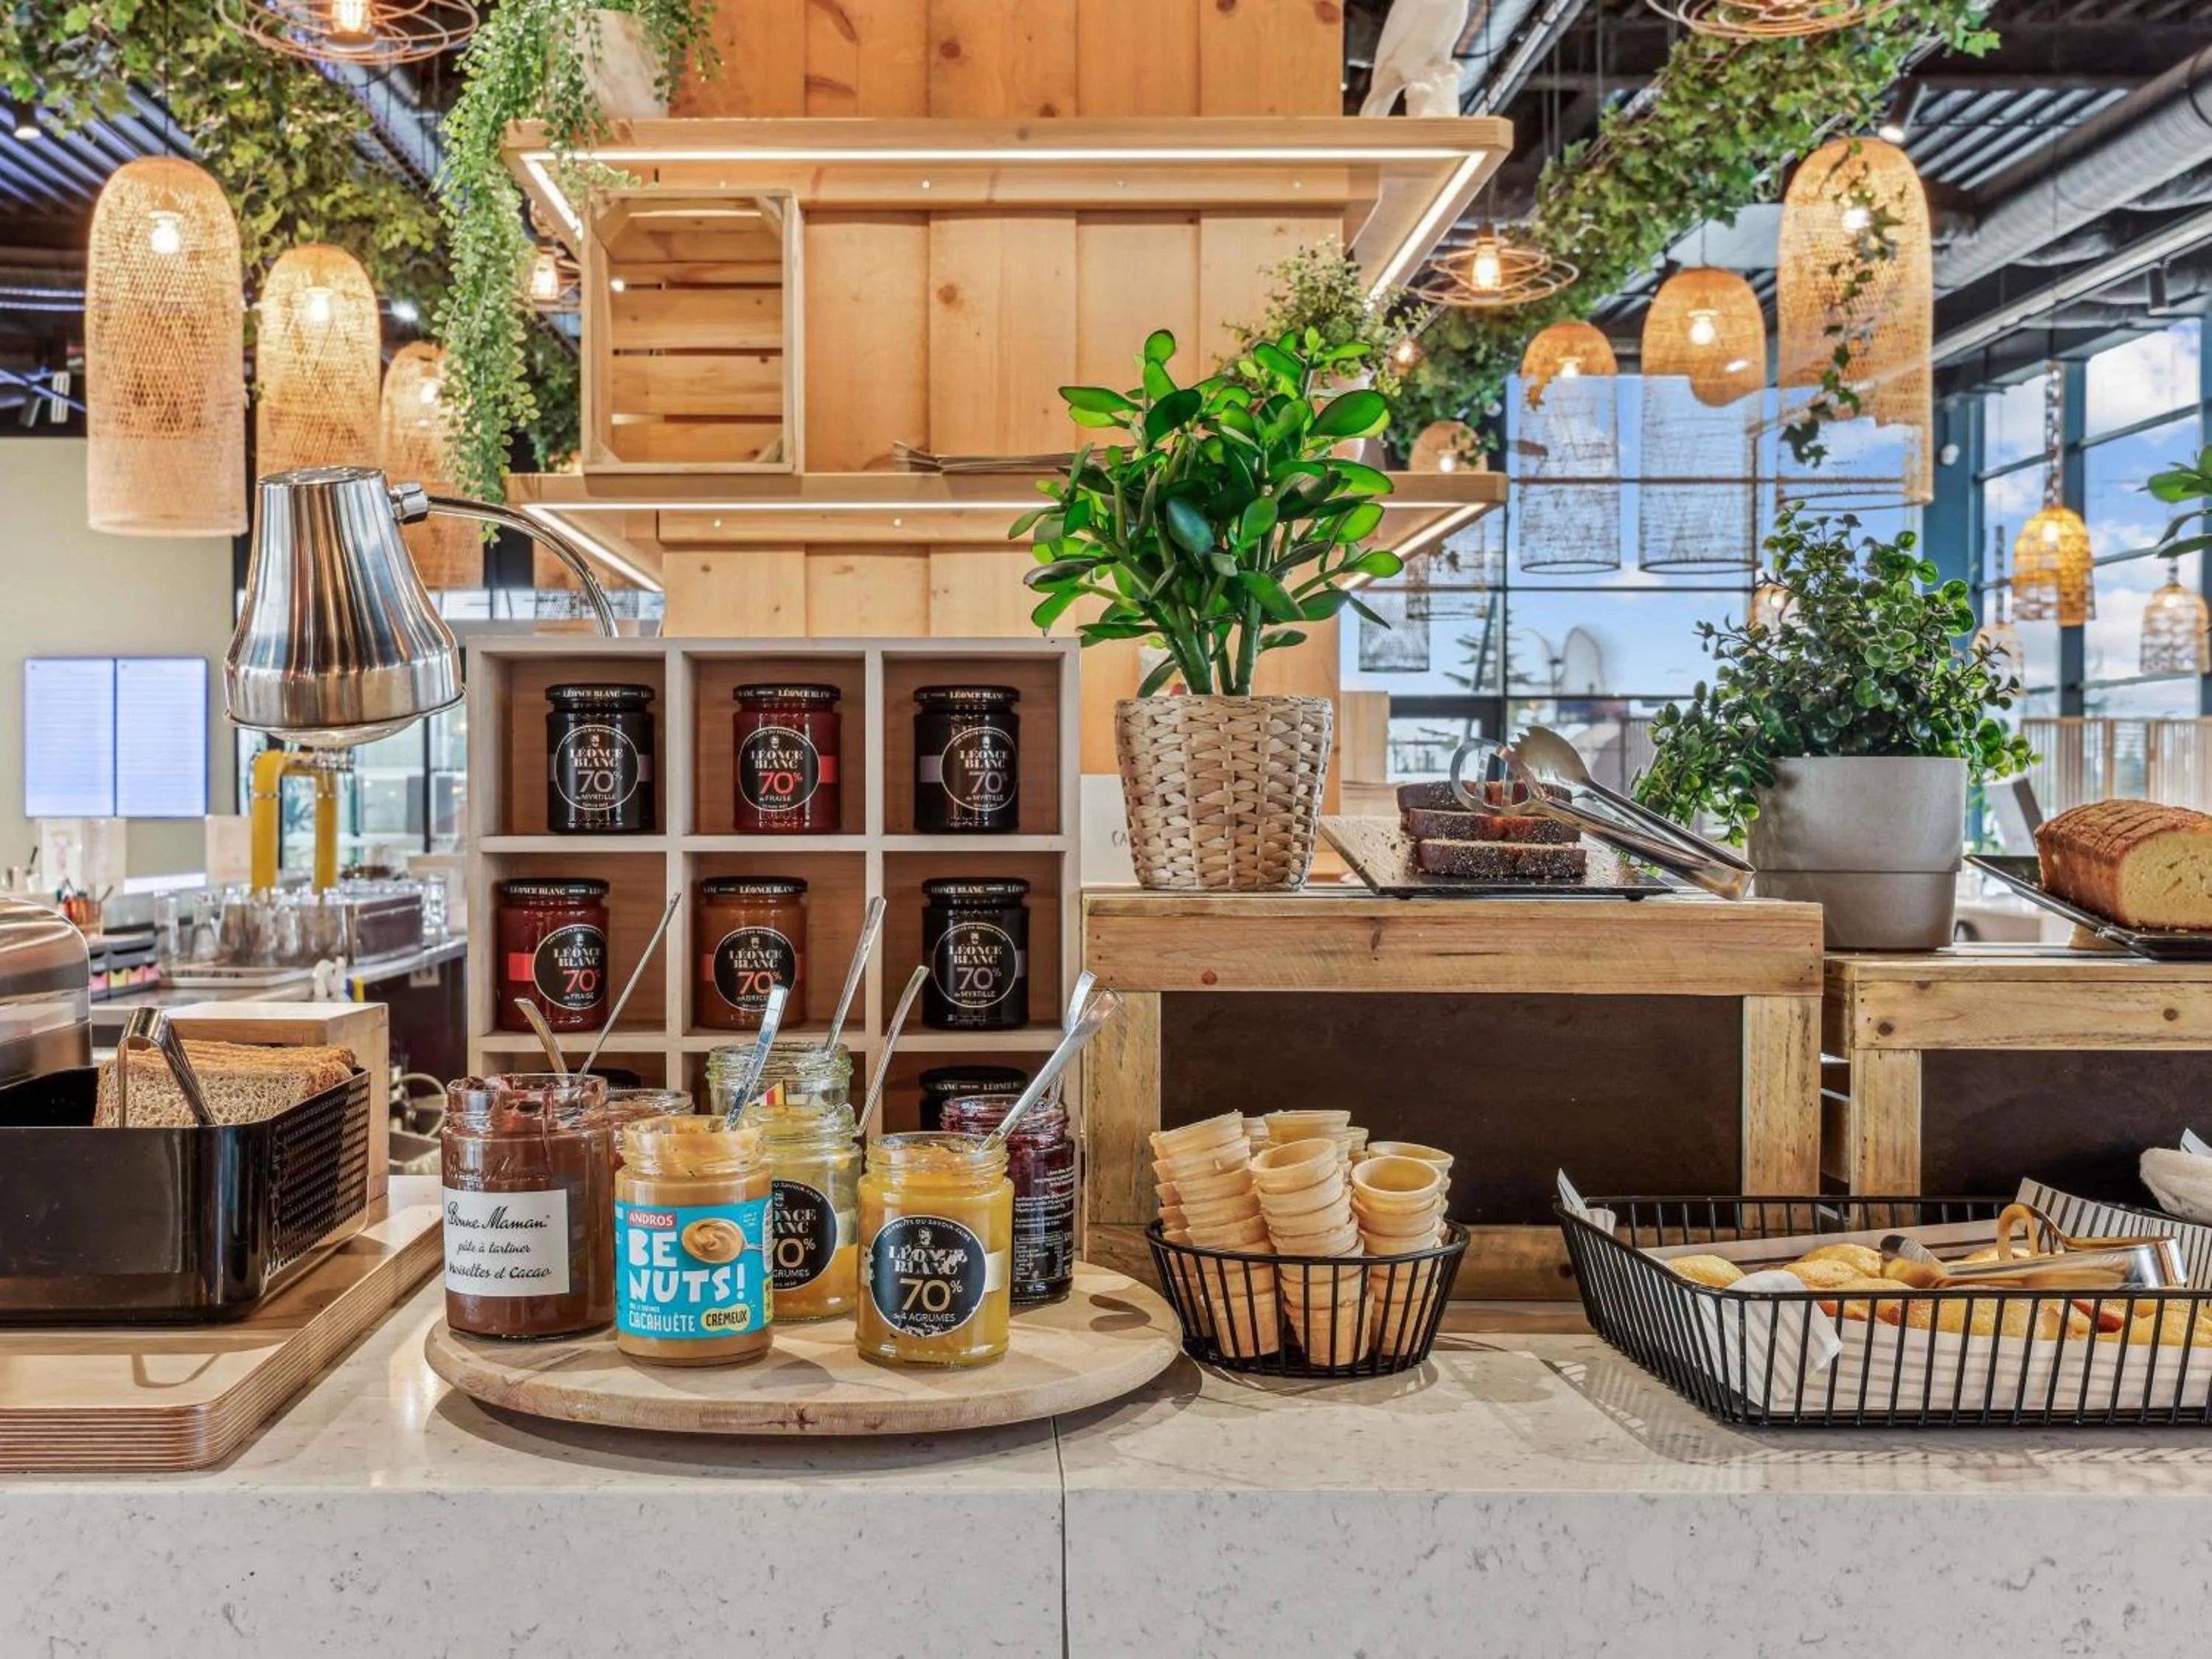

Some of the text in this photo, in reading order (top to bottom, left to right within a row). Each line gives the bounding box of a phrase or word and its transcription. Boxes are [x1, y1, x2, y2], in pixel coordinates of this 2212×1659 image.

[569, 746, 624, 759] LÉONCE
[751, 748, 804, 760] LÉONCE
[574, 757, 620, 768] BLANC
[754, 759, 798, 770] BLANC
[964, 759, 1006, 769] BLANC
[758, 771, 804, 795] 70%
[729, 947, 783, 959] LÉONCE
[948, 943, 1003, 956] LÉONCE
[558, 957, 598, 967] BLANC
[733, 959, 778, 969] BLANC
[953, 955, 998, 965] BLANC
[956, 966, 1002, 990] 70%
[961, 990, 995, 998] MYRTILLE
[629, 1212, 674, 1227] ANDROS
[773, 1208, 817, 1222] ONCE
[773, 1221, 810, 1234] ANC
[489, 1241, 532, 1254] tartiner
[627, 1228, 678, 1267] BE
[773, 1269, 810, 1278] GRUMES
[628, 1263, 745, 1304] NUTS!
[899, 1277, 964, 1312] 70%
[628, 1309, 696, 1332] CACAHUÈTE
[705, 1309, 748, 1327] CRÉMEUX
[908, 1312, 956, 1322] AGRUMES
